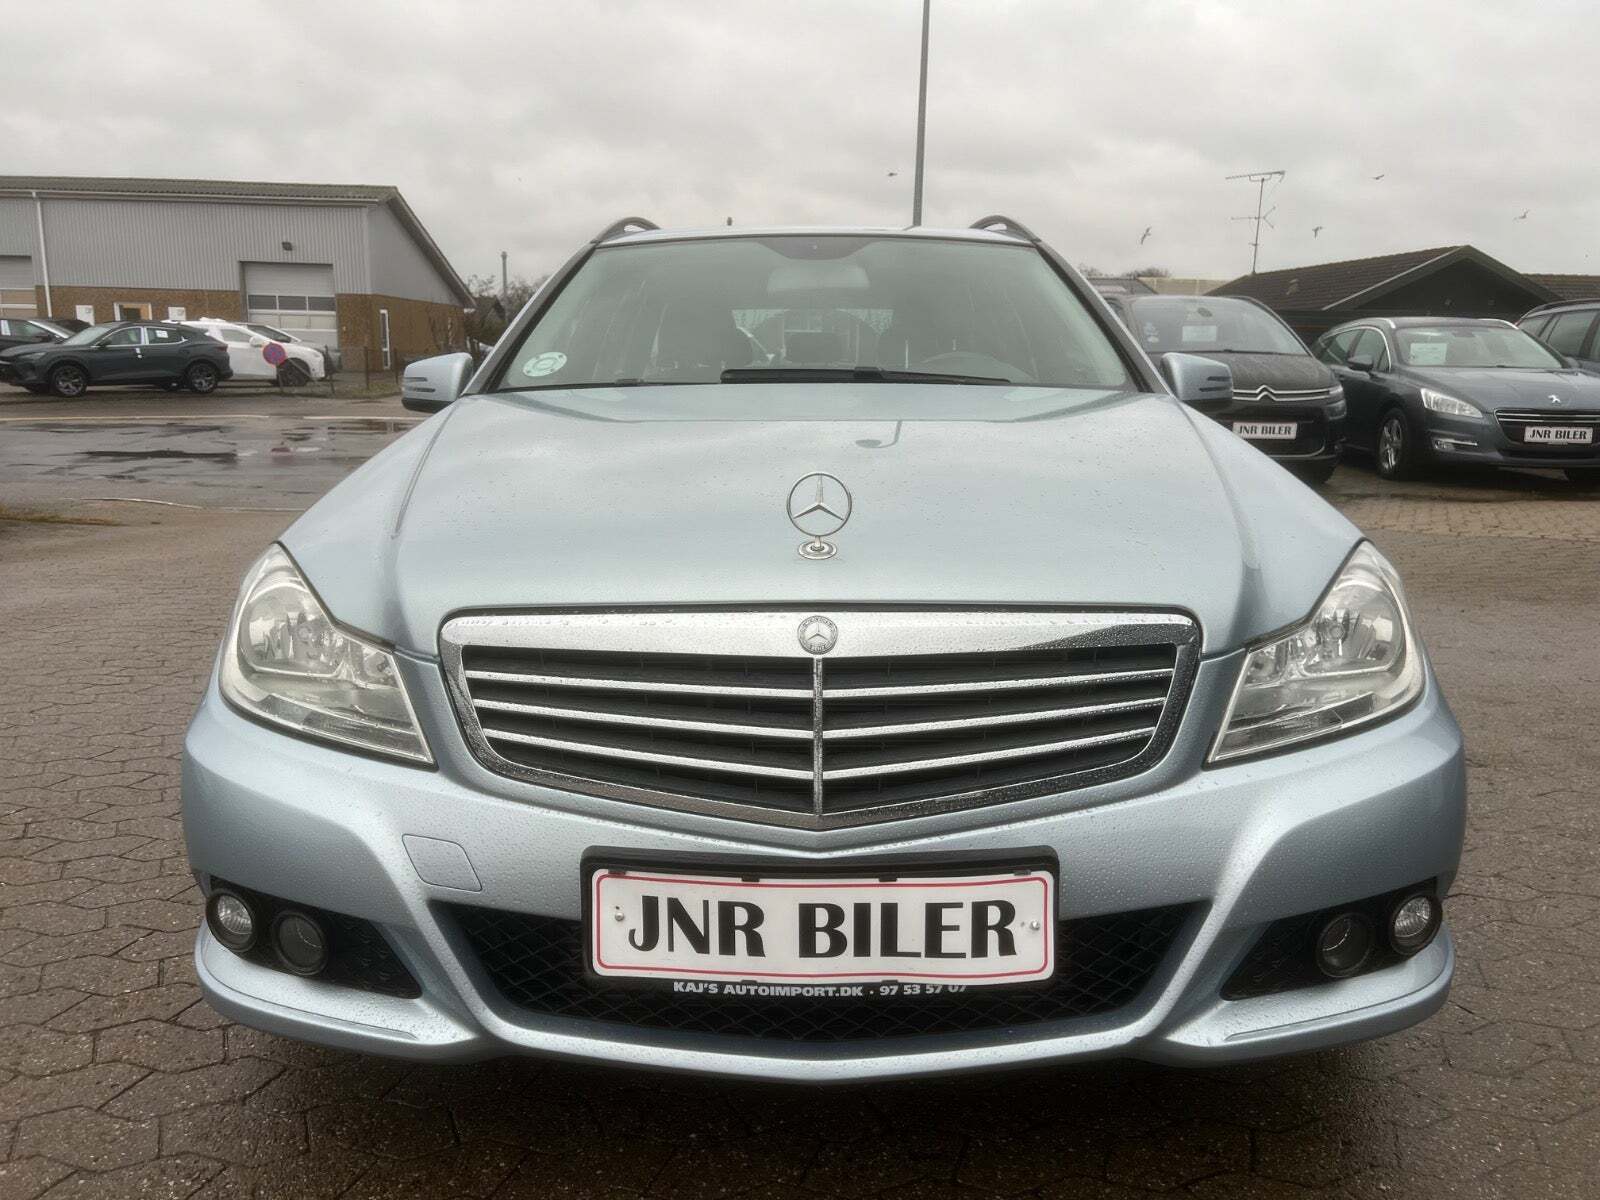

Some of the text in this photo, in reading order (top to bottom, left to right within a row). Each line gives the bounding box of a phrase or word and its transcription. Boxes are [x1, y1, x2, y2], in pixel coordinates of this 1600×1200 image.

[1239, 425, 1291, 435] JNR BILER
[1530, 429, 1587, 440] JNR BILER
[628, 895, 1017, 959] JNR BILER
[673, 981, 718, 994] KAJ'S
[723, 984, 863, 997] AUTOIMPORT.DK
[880, 985, 898, 996] 97
[903, 984, 921, 995] 53
[925, 984, 943, 994] 57
